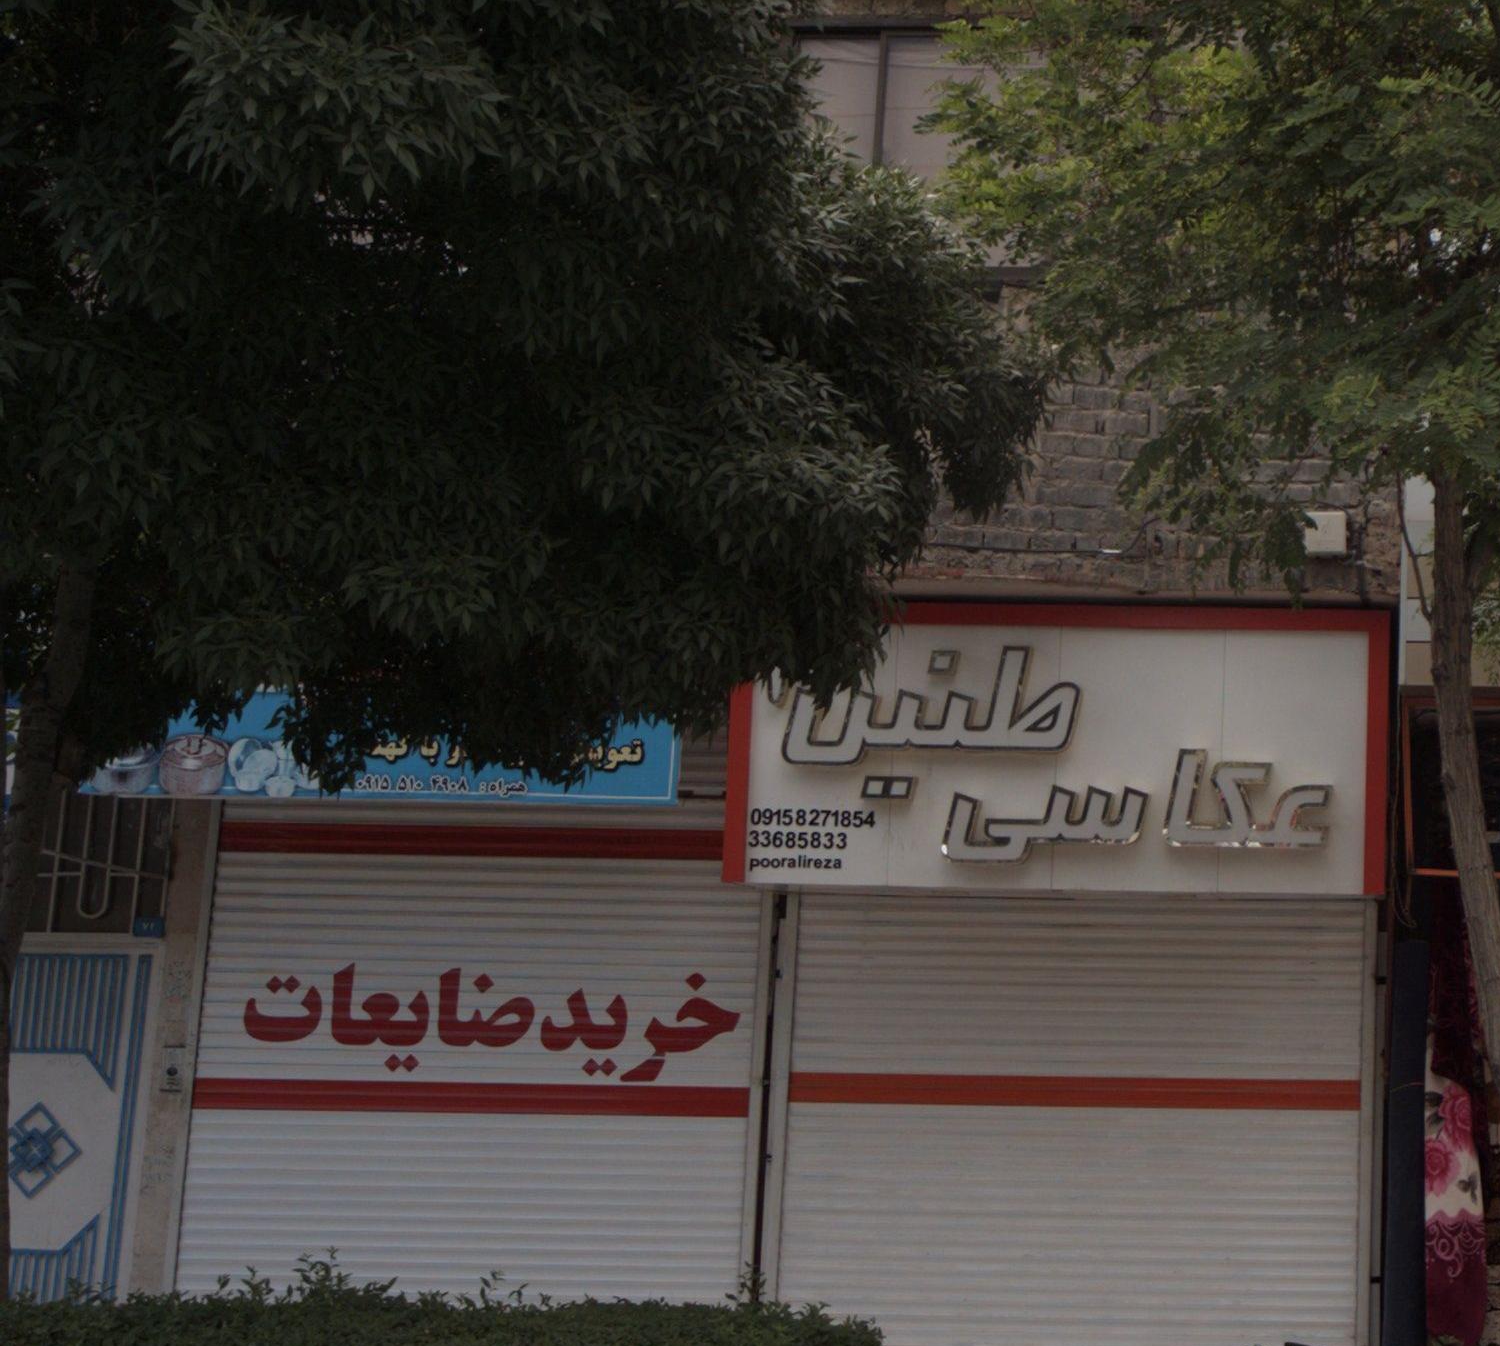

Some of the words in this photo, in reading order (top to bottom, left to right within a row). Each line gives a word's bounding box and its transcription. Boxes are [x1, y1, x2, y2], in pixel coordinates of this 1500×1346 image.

[941, 748, 1333, 863] عکاسی
[750, 808, 876, 828] 09158271854
[748, 830, 848, 849] 33685833
[749, 855, 843, 872] pooralireza
